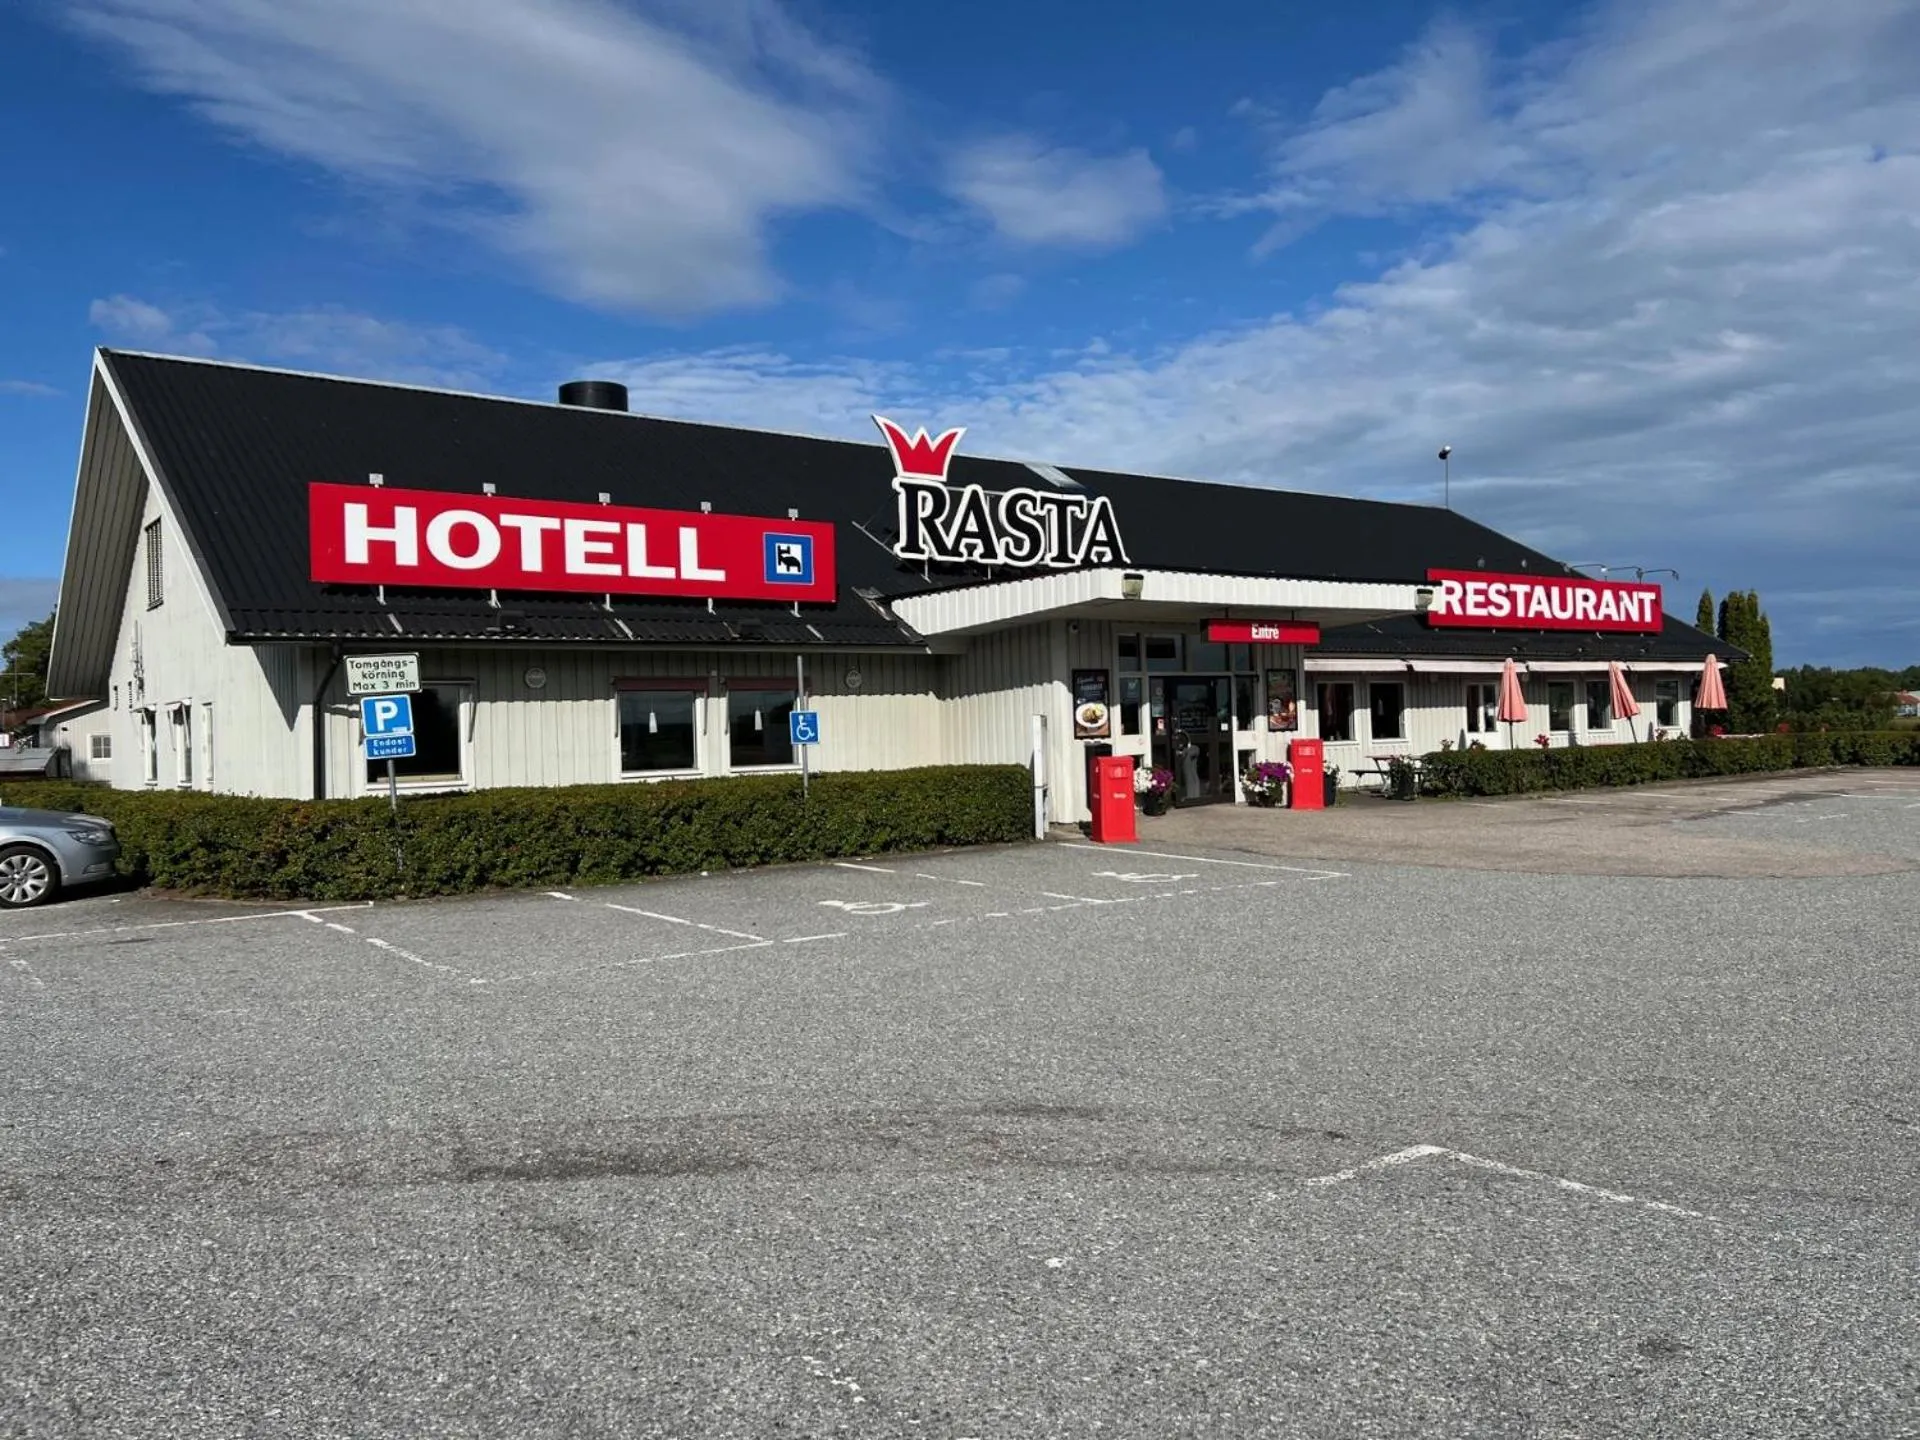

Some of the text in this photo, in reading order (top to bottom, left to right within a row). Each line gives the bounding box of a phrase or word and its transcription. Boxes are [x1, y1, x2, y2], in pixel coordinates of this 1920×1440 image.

[891, 477, 1131, 567] RASTA
[344, 503, 726, 582] HOTELL
[1438, 580, 1656, 623] RESTAURANT
[1251, 625, 1280, 639] Entré
[349, 659, 416, 670] Tomgångs-
[361, 670, 405, 680] körning
[353, 680, 415, 690] Max 3 min
[374, 701, 398, 731] P
[373, 738, 406, 747] Endast
[373, 747, 406, 755] kunder
